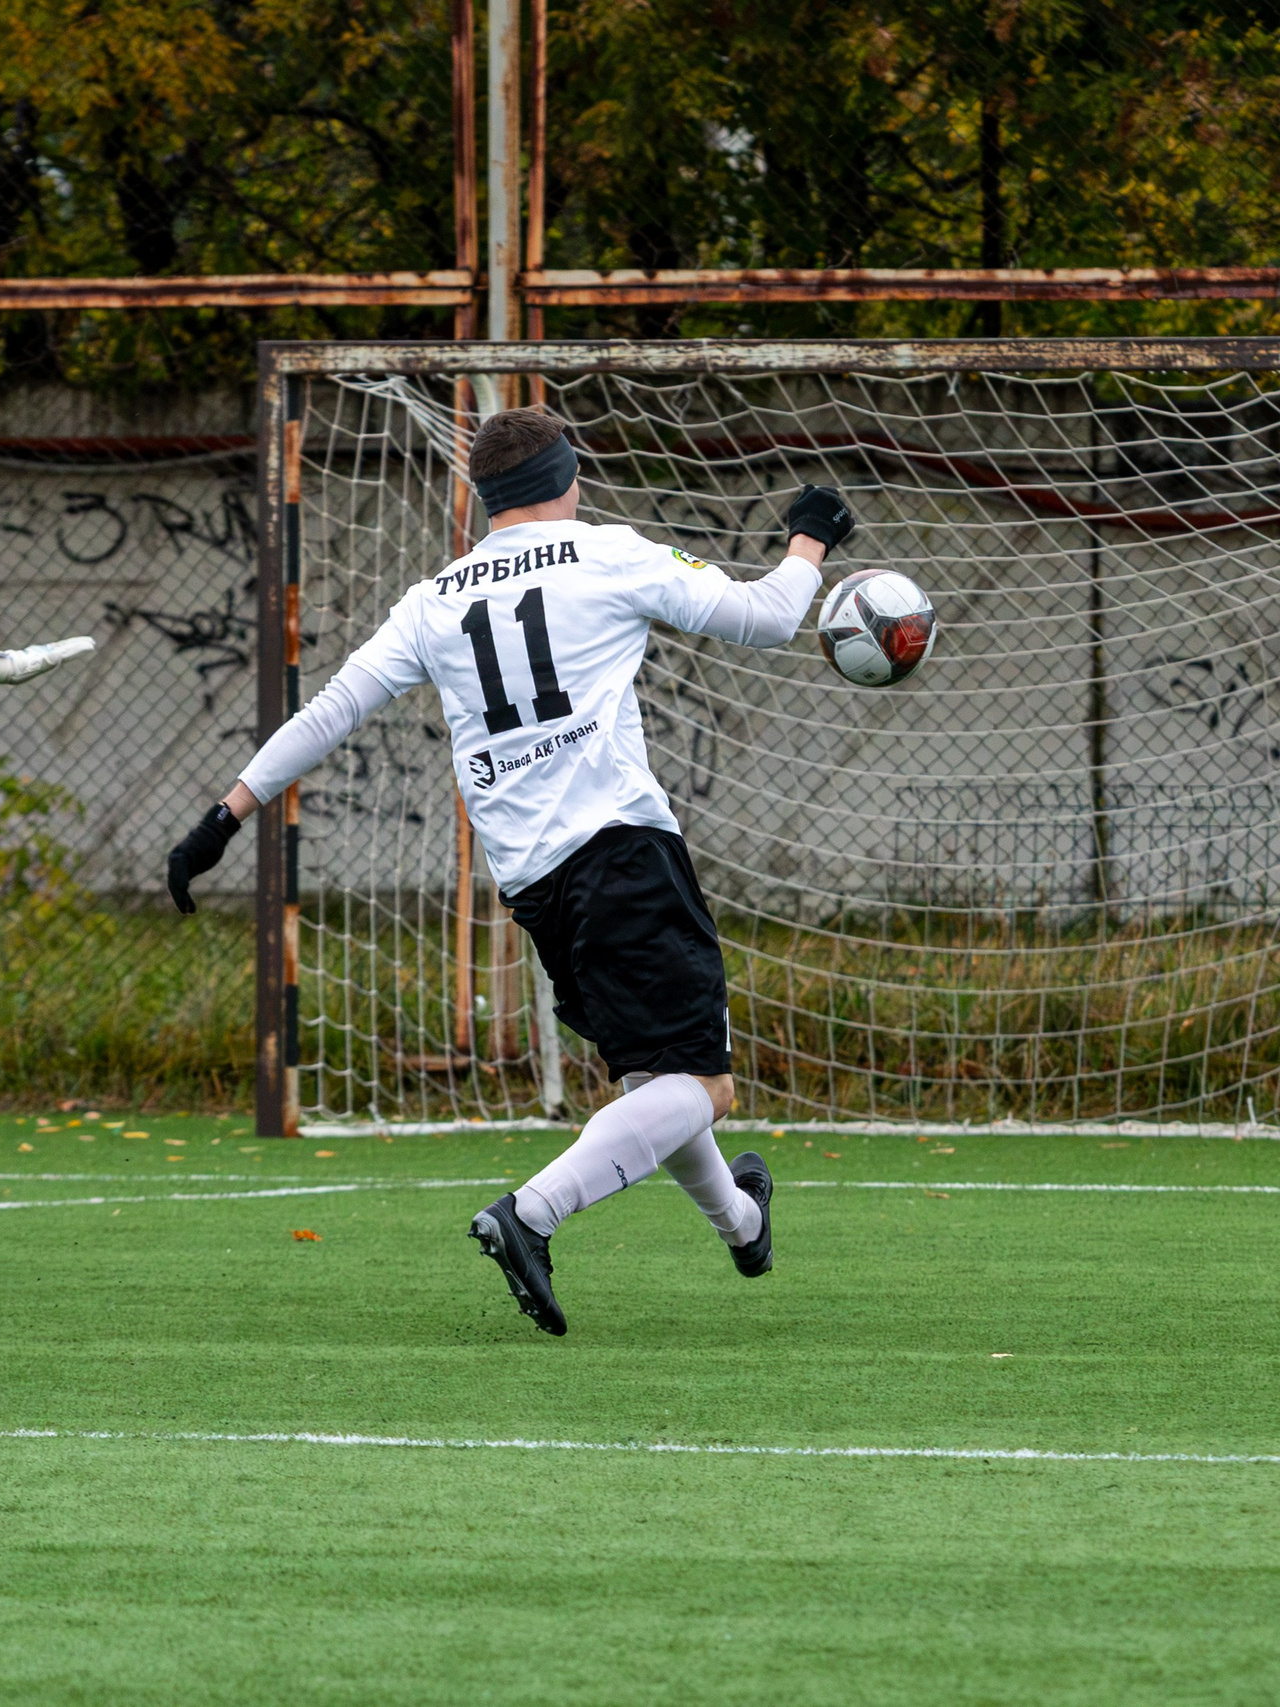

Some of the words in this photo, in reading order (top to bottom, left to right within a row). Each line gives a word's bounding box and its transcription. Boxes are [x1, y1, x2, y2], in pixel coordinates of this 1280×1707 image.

[435, 540, 580, 596] ТУРБИНА
[460, 586, 573, 736] 11
[497, 753, 533, 773] Завод
[554, 720, 599, 749] Гарант
